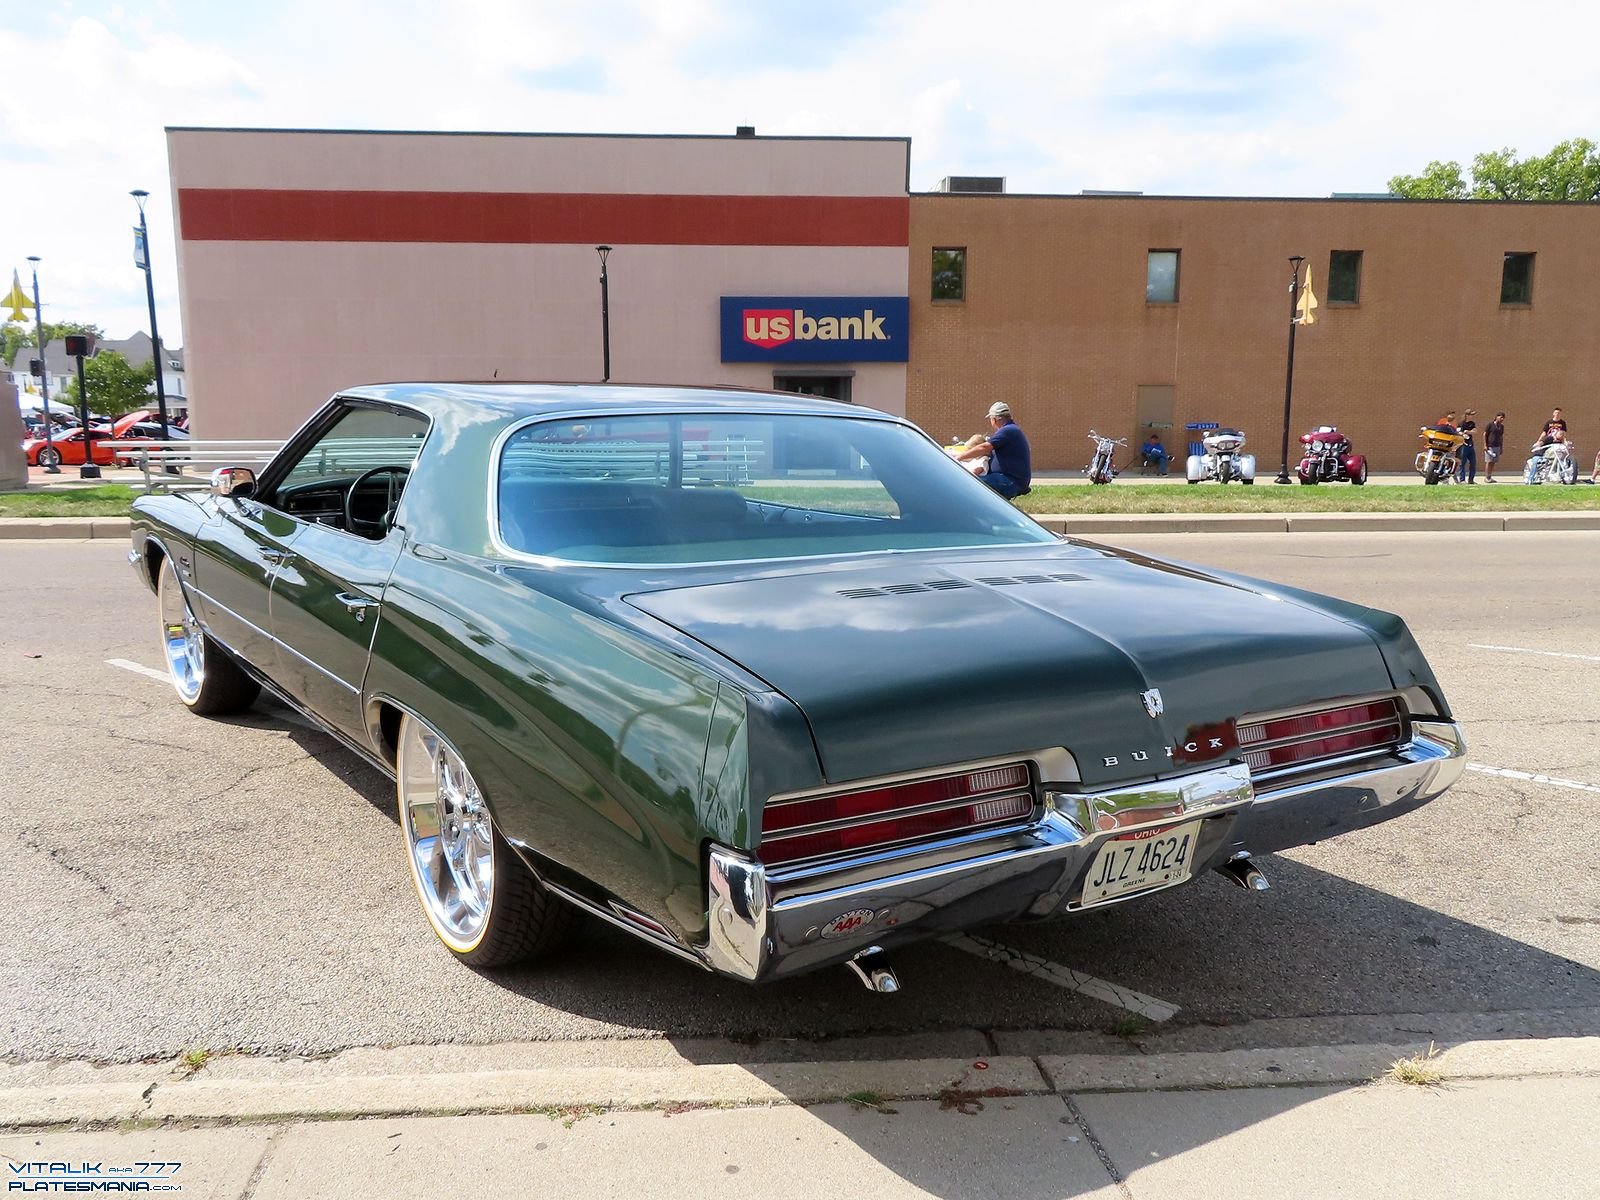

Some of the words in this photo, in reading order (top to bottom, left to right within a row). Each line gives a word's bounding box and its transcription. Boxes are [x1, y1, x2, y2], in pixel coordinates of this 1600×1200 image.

[1103, 737, 1223, 767] BUICK
[1093, 846, 1135, 887] JLZ
[1137, 834, 1190, 874] 4624
[1122, 878, 1146, 888] GREENE
[832, 917, 862, 932] AAA
